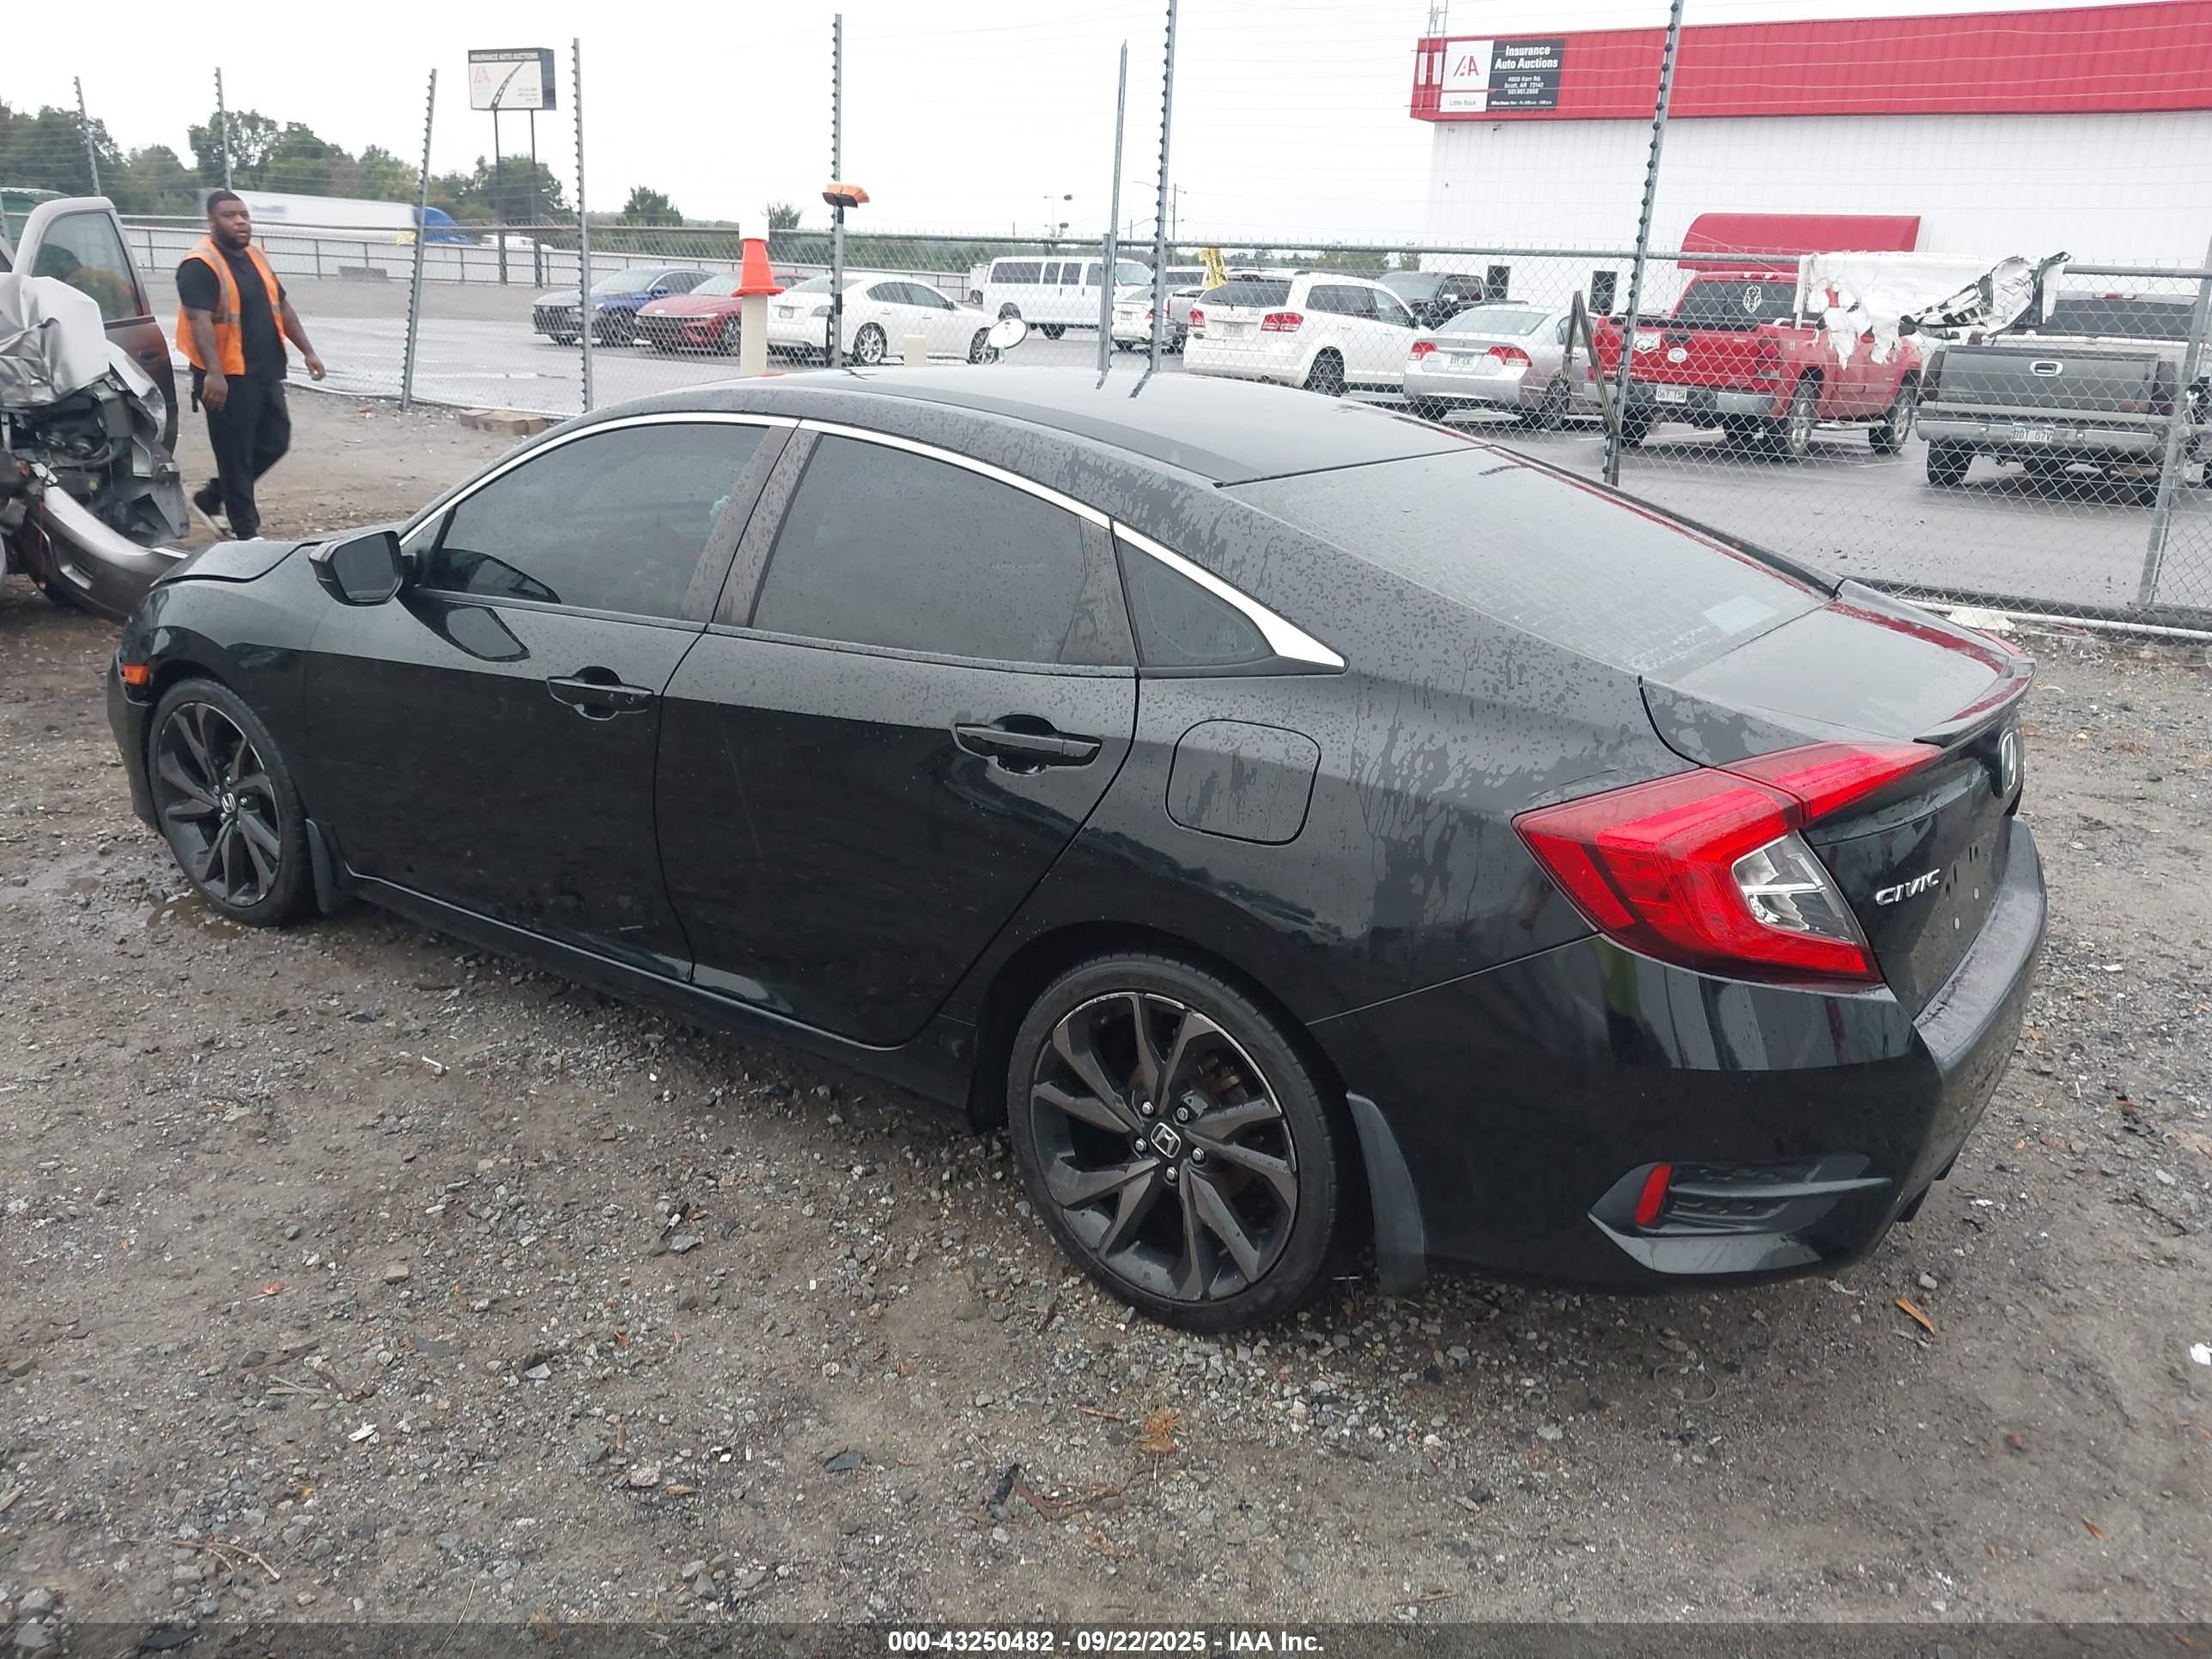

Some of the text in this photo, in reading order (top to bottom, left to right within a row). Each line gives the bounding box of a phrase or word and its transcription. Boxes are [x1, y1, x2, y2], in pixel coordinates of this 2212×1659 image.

[1504, 46, 1551, 57] Insurance
[1495, 58, 1559, 70] Auto Auctions
[1875, 869, 1940, 906] CIVIC
